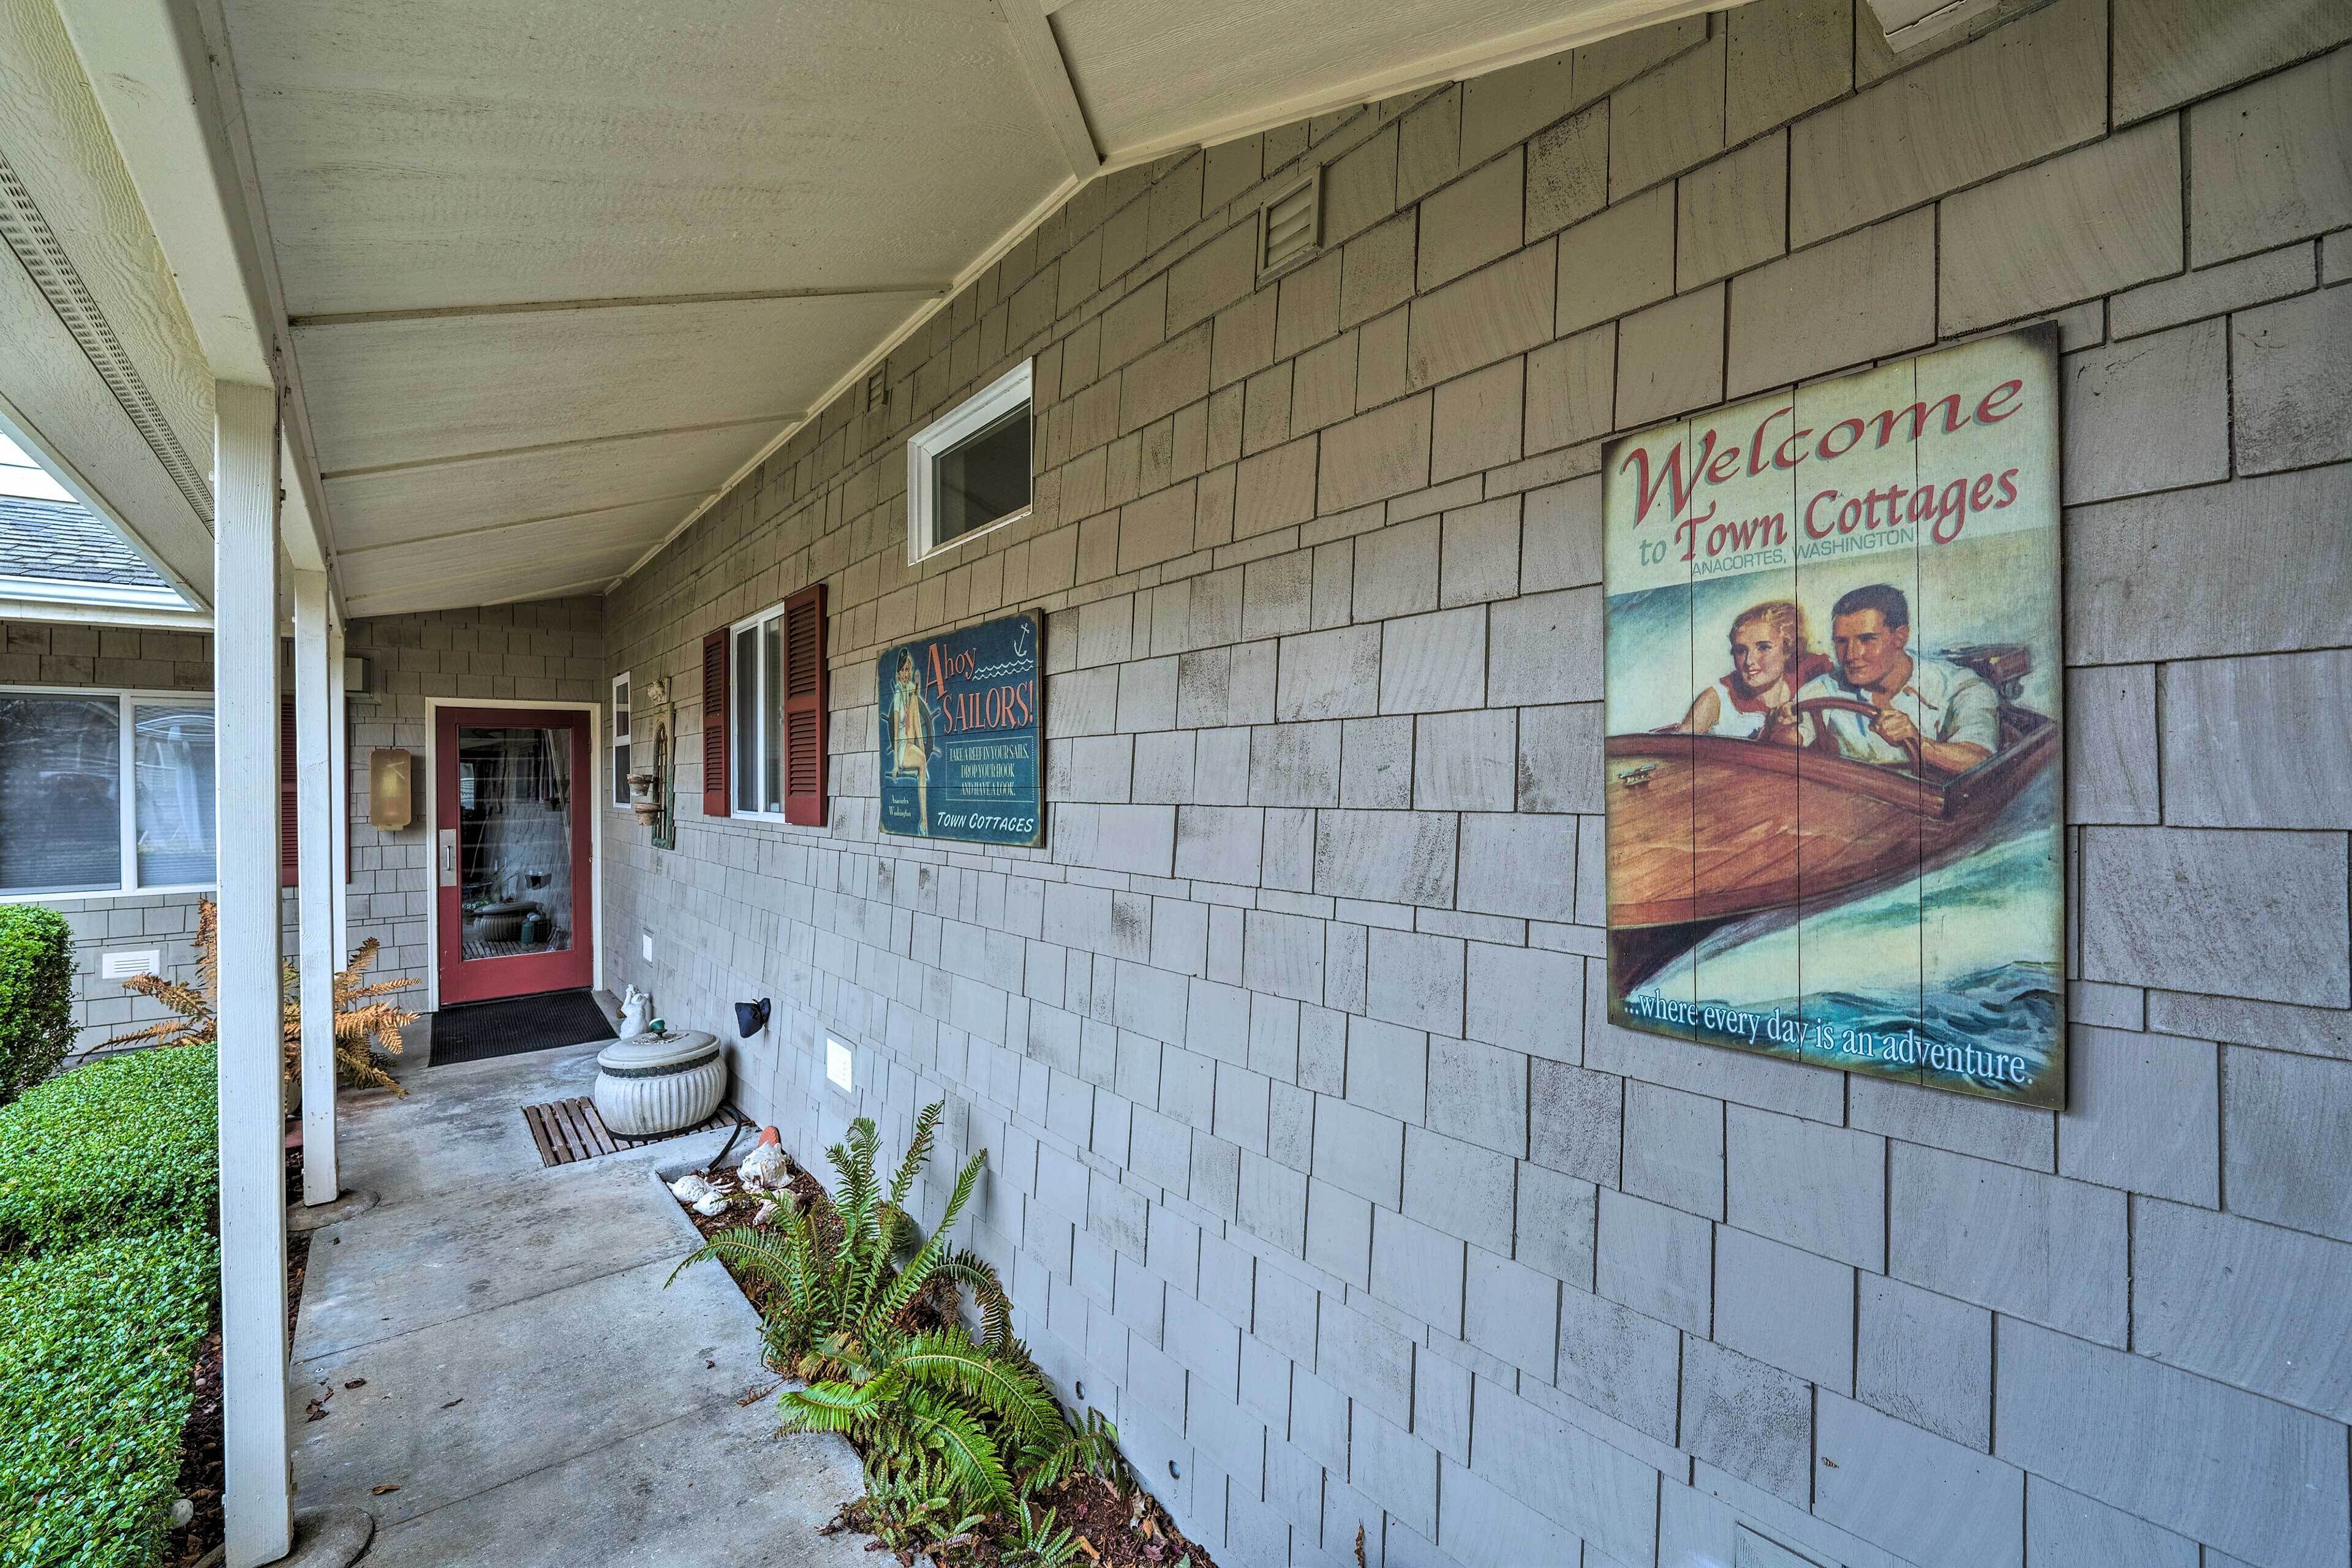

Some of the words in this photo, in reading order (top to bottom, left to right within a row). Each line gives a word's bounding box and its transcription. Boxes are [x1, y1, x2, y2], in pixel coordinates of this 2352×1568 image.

[1620, 379, 2024, 529] Welcome
[1640, 538, 1666, 567] to
[1675, 497, 1788, 562] Town
[1804, 467, 2019, 545] Cottages
[1692, 549, 1787, 576] ANACORTES,
[1792, 527, 1915, 559] WASHINGTON
[924, 643, 977, 706] Ahoy
[943, 680, 1035, 734] SAILORS!
[950, 748, 963, 761] TAKE
[963, 748, 968, 761] A
[969, 747, 982, 760] REEF
[983, 746, 990, 760] IN
[990, 745, 1009, 760] YOUR
[961, 764, 978, 778] DROP
[977, 763, 995, 777] YOUR
[997, 763, 1015, 777] HOOK
[889, 805, 911, 818] Washington
[960, 782, 974, 796] AND
[974, 782, 990, 796] HAVE
[991, 782, 996, 796] A
[938, 812, 967, 827] TOWN
[969, 813, 1035, 833] COTTAGES
[1703, 1005, 1762, 1044] every
[1767, 1008, 1807, 1054] day
[1815, 1017, 1835, 1048] is
[1841, 1028, 1874, 1057] an
[1882, 1028, 2034, 1085] adventure.
